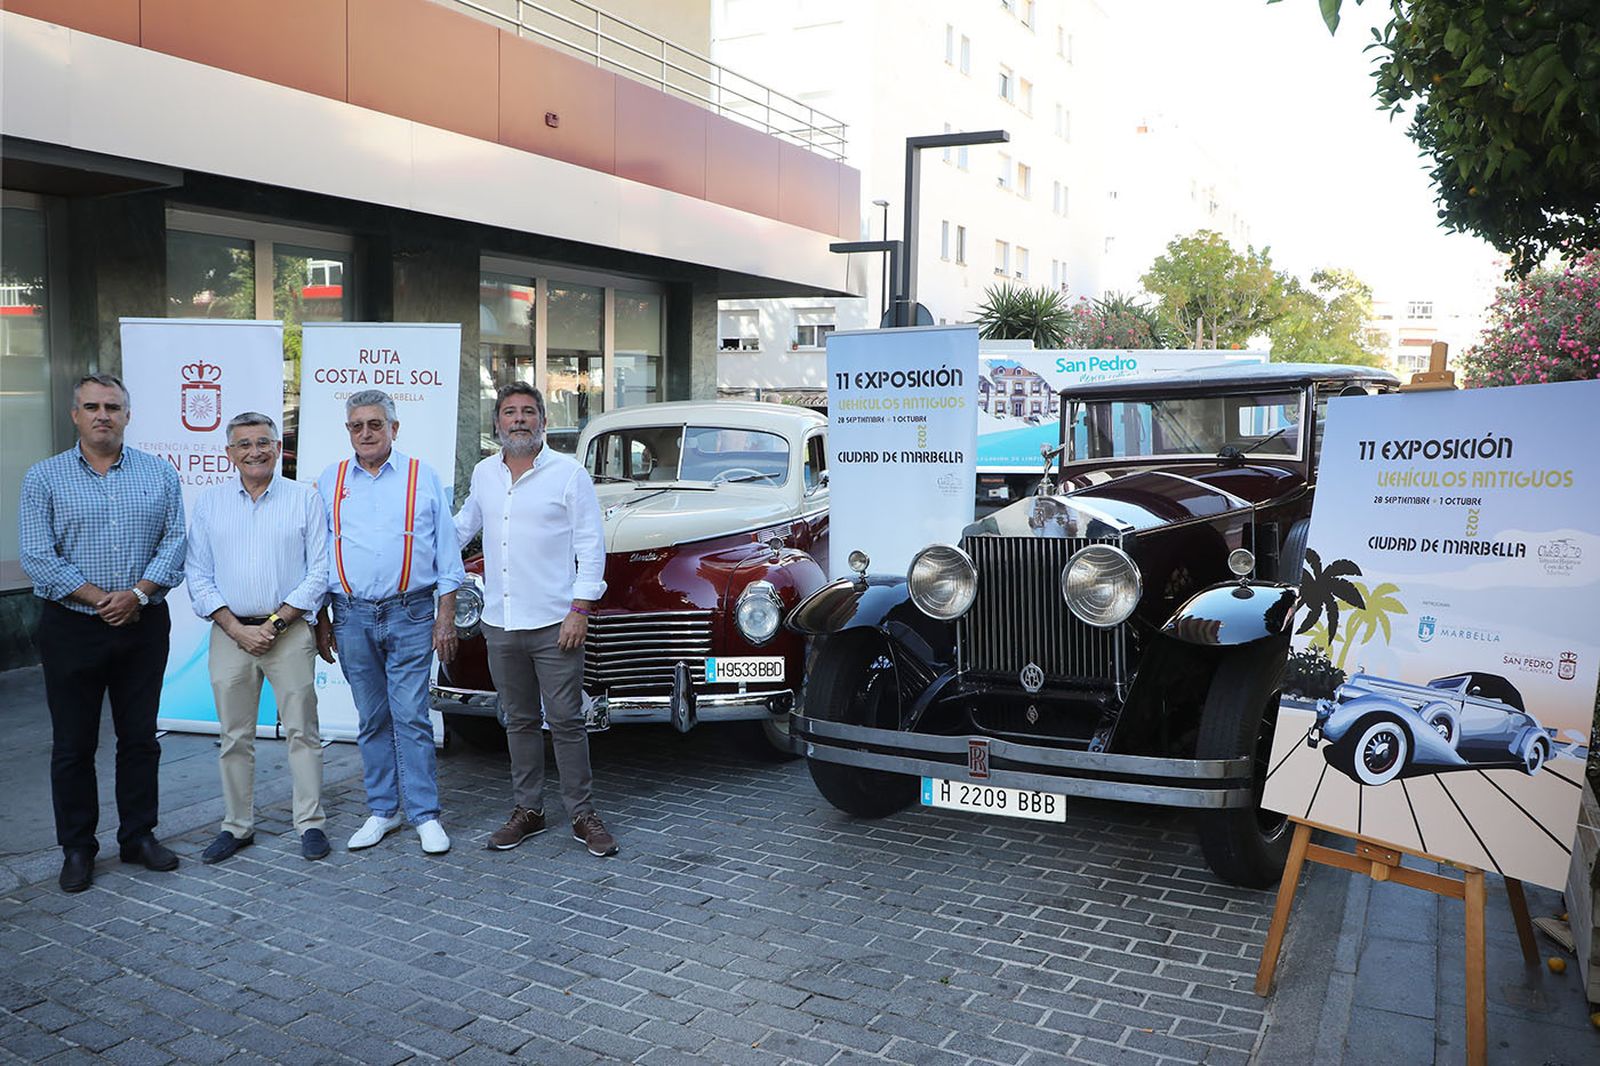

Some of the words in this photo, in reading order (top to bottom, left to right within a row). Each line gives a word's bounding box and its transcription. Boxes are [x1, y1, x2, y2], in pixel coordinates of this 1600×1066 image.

[359, 349, 401, 364] RUTA
[1055, 357, 1086, 373] San
[1089, 355, 1137, 371] Pedro
[314, 368, 368, 384] COSTA
[374, 369, 405, 385] DEL
[410, 370, 443, 386] SOL
[835, 372, 849, 390] 11
[854, 364, 963, 389] EXPOSICIÓN
[388, 392, 425, 401] ARBELLA
[902, 396, 966, 410] ANTIGUOS
[896, 415, 927, 423] OCTUBRE
[917, 424, 927, 449] 2023
[138, 442, 189, 451] TENENCIA
[193, 443, 206, 452] DE
[1359, 440, 1376, 460] 11
[1381, 432, 1513, 460] EXPOSICIÓN
[188, 454, 237, 473] PED
[837, 450, 879, 464] CIUDAD
[882, 450, 897, 463] DE
[901, 450, 964, 464] MARBELLA
[1377, 467, 1467, 488] VEHÍCULOS
[1471, 469, 1574, 489] ANTIGUOS
[1373, 496, 1383, 504] 28
[1384, 496, 1430, 505] SEPTIEMBRE
[1439, 497, 1443, 505] 1
[1444, 497, 1482, 506] OCTUBRE
[1465, 508, 1481, 537] 2023
[1367, 536, 1417, 552] CIUDAD
[1420, 538, 1439, 554] DE
[1442, 539, 1527, 558] MARBELLA
[1440, 629, 1501, 642] MARBELLA
[716, 661, 783, 677] H9533BBD
[1503, 655, 1521, 665] SAN
[1523, 658, 1554, 670] PEDRO
[941, 783, 951, 802] H
[959, 785, 1007, 809] 2209
[1018, 791, 1056, 815] BBB
